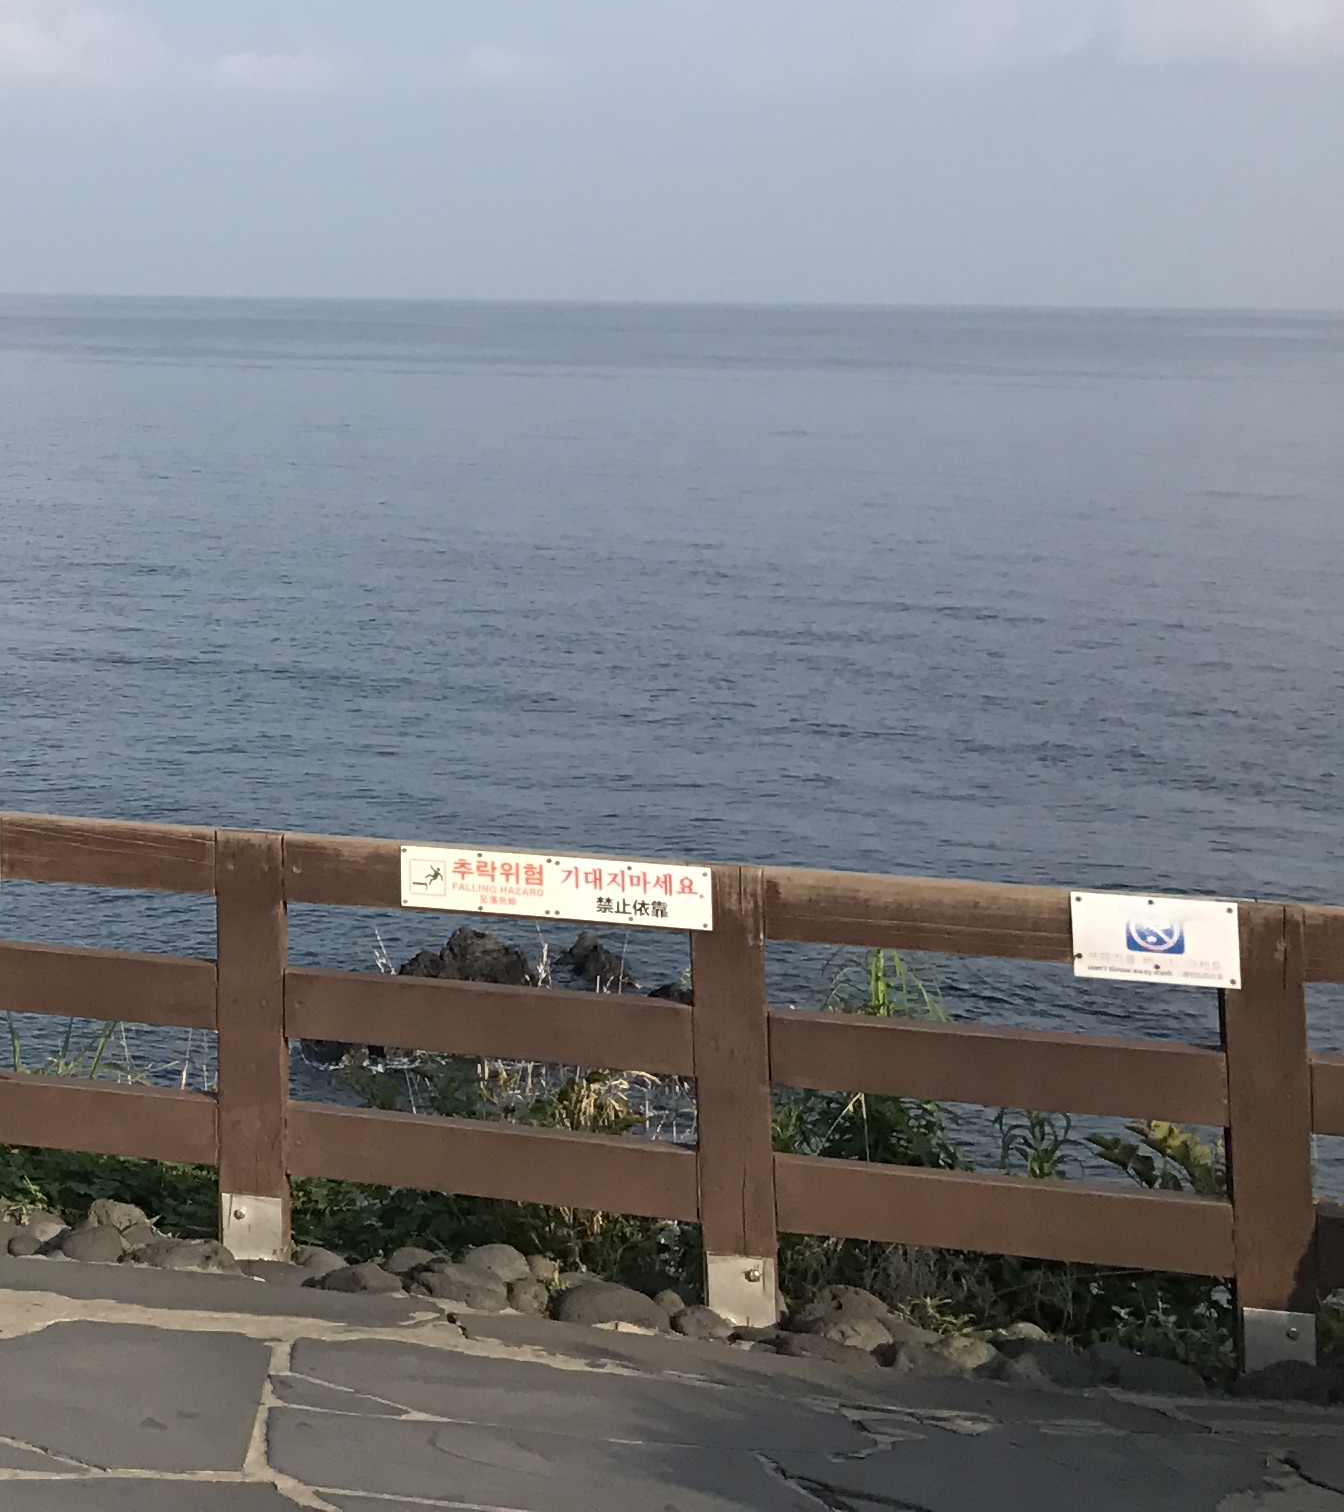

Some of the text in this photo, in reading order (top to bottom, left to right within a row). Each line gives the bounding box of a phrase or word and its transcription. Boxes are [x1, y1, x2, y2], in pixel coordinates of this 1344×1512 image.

[452, 858, 544, 886] 추락위험
[452, 882, 545, 897] FALLING HAZARD
[595, 896, 669, 918] 禁止依靠
